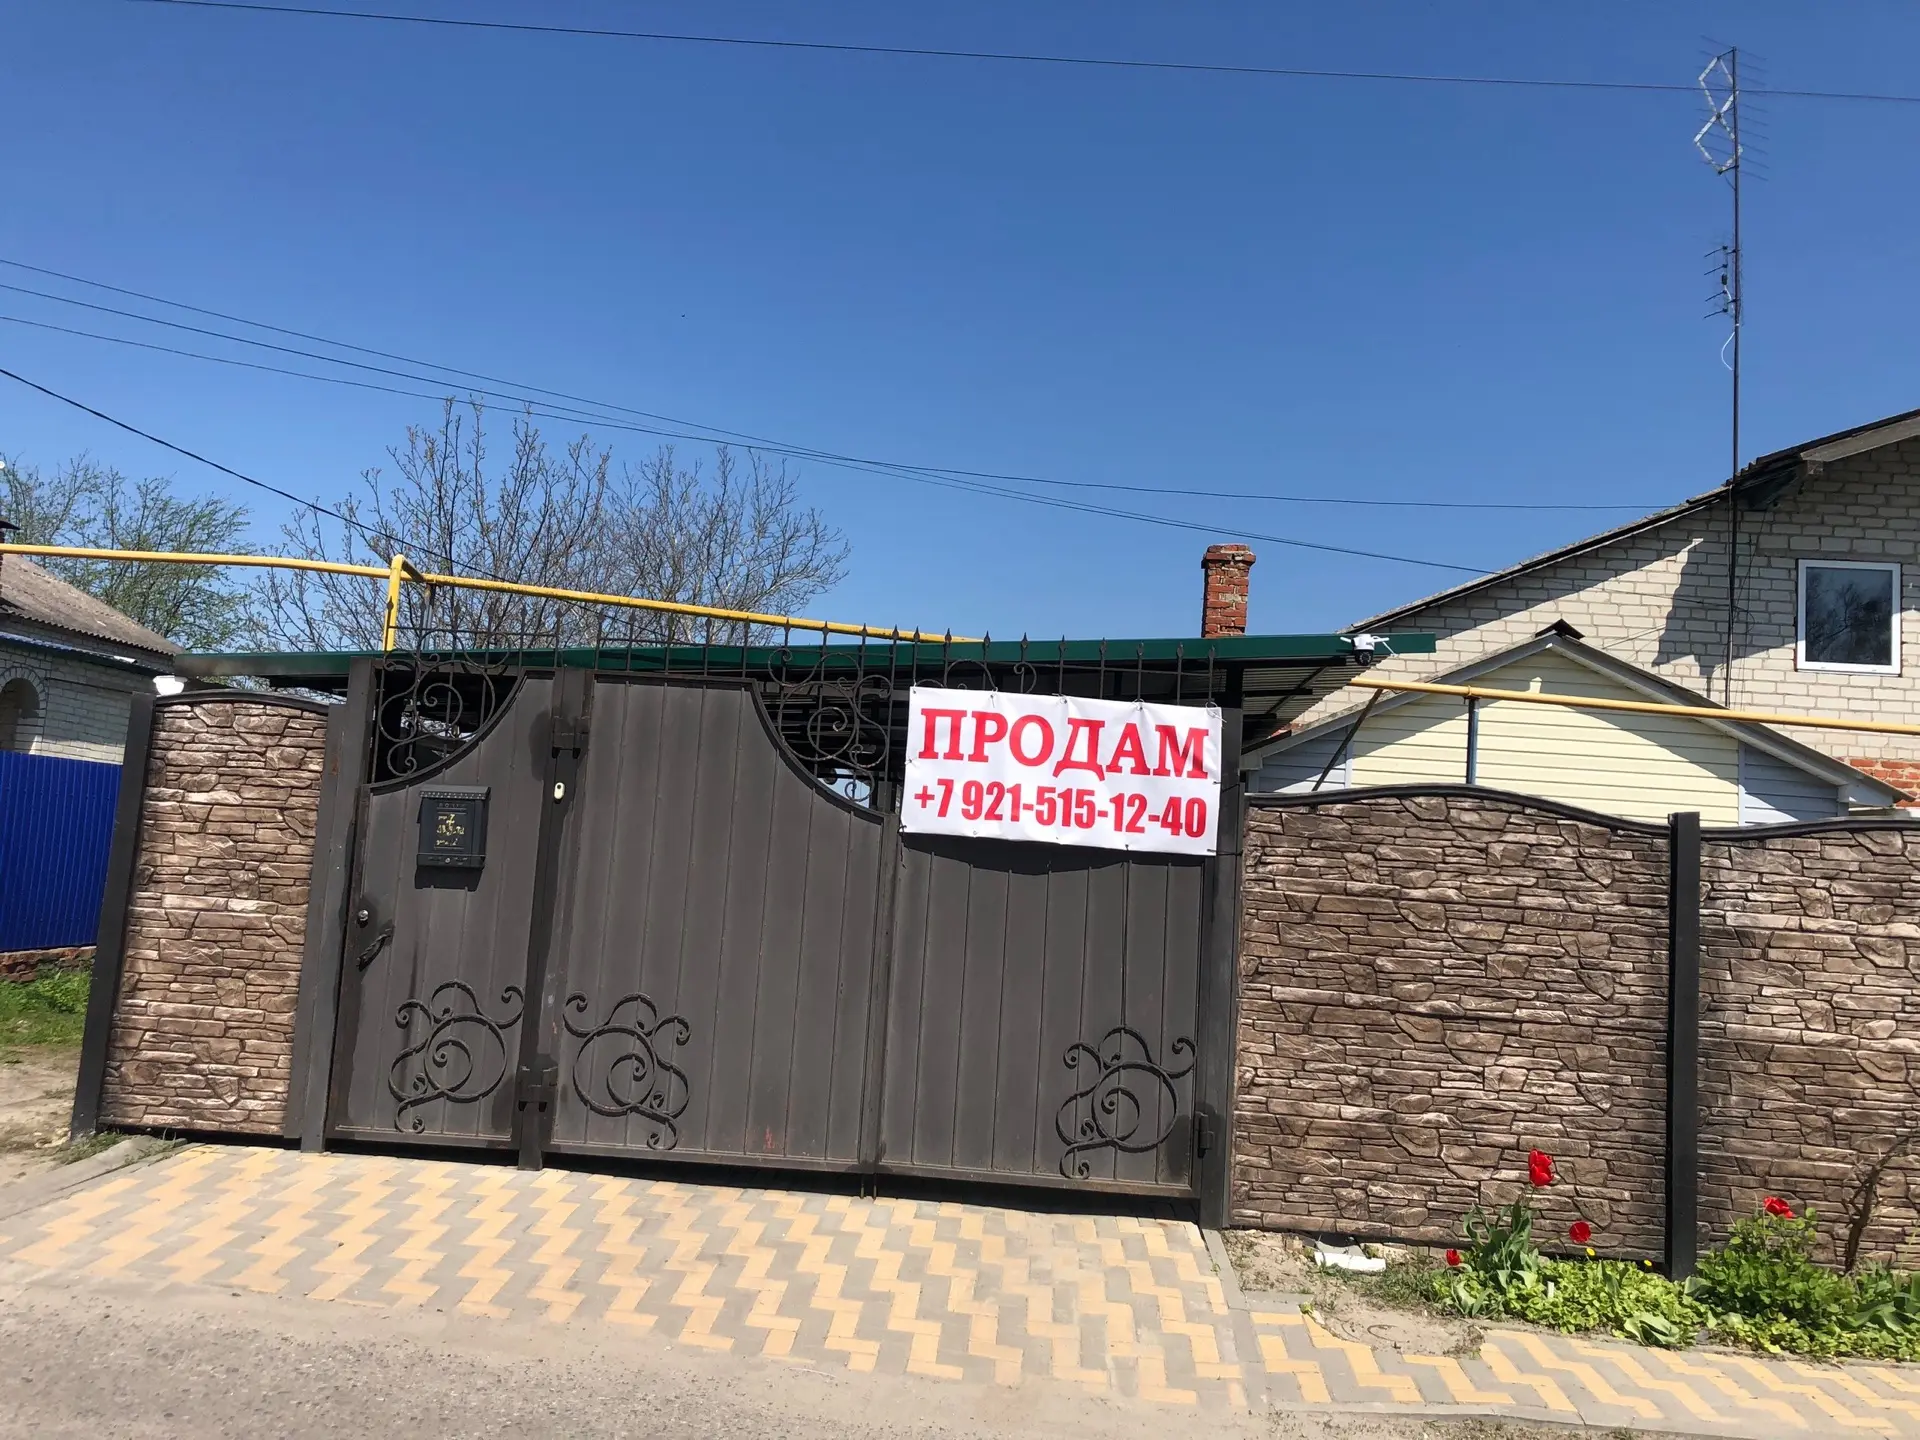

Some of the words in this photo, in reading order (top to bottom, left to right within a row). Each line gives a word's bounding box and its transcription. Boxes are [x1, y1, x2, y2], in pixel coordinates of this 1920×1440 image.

[918, 707, 1209, 781] ПРОДАМ
[914, 778, 955, 818] +7
[961, 780, 1207, 838] 921-515-12-40
